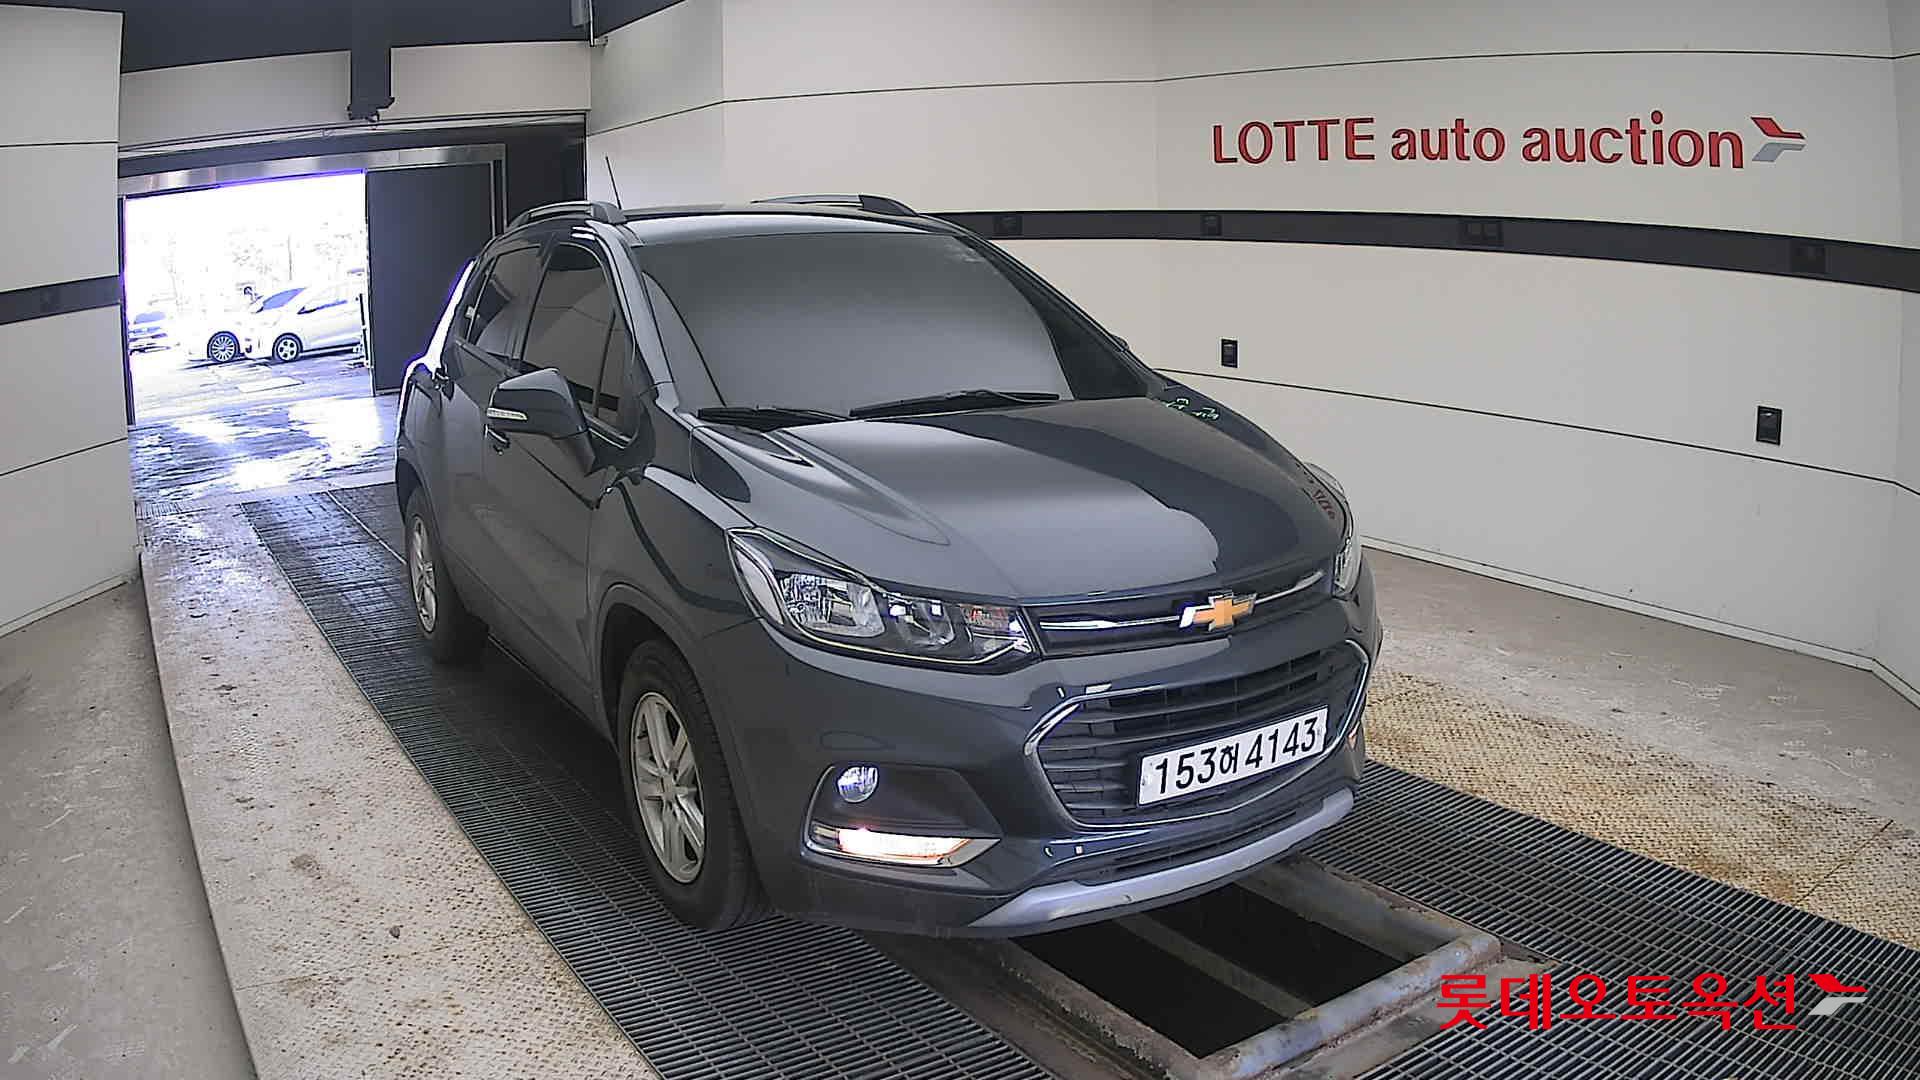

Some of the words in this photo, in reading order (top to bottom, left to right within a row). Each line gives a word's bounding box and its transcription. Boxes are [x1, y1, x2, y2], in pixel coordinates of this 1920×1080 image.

[1212, 117, 1376, 164] LOTTE
[1391, 118, 1506, 162] auto
[1521, 110, 1745, 169] auction
